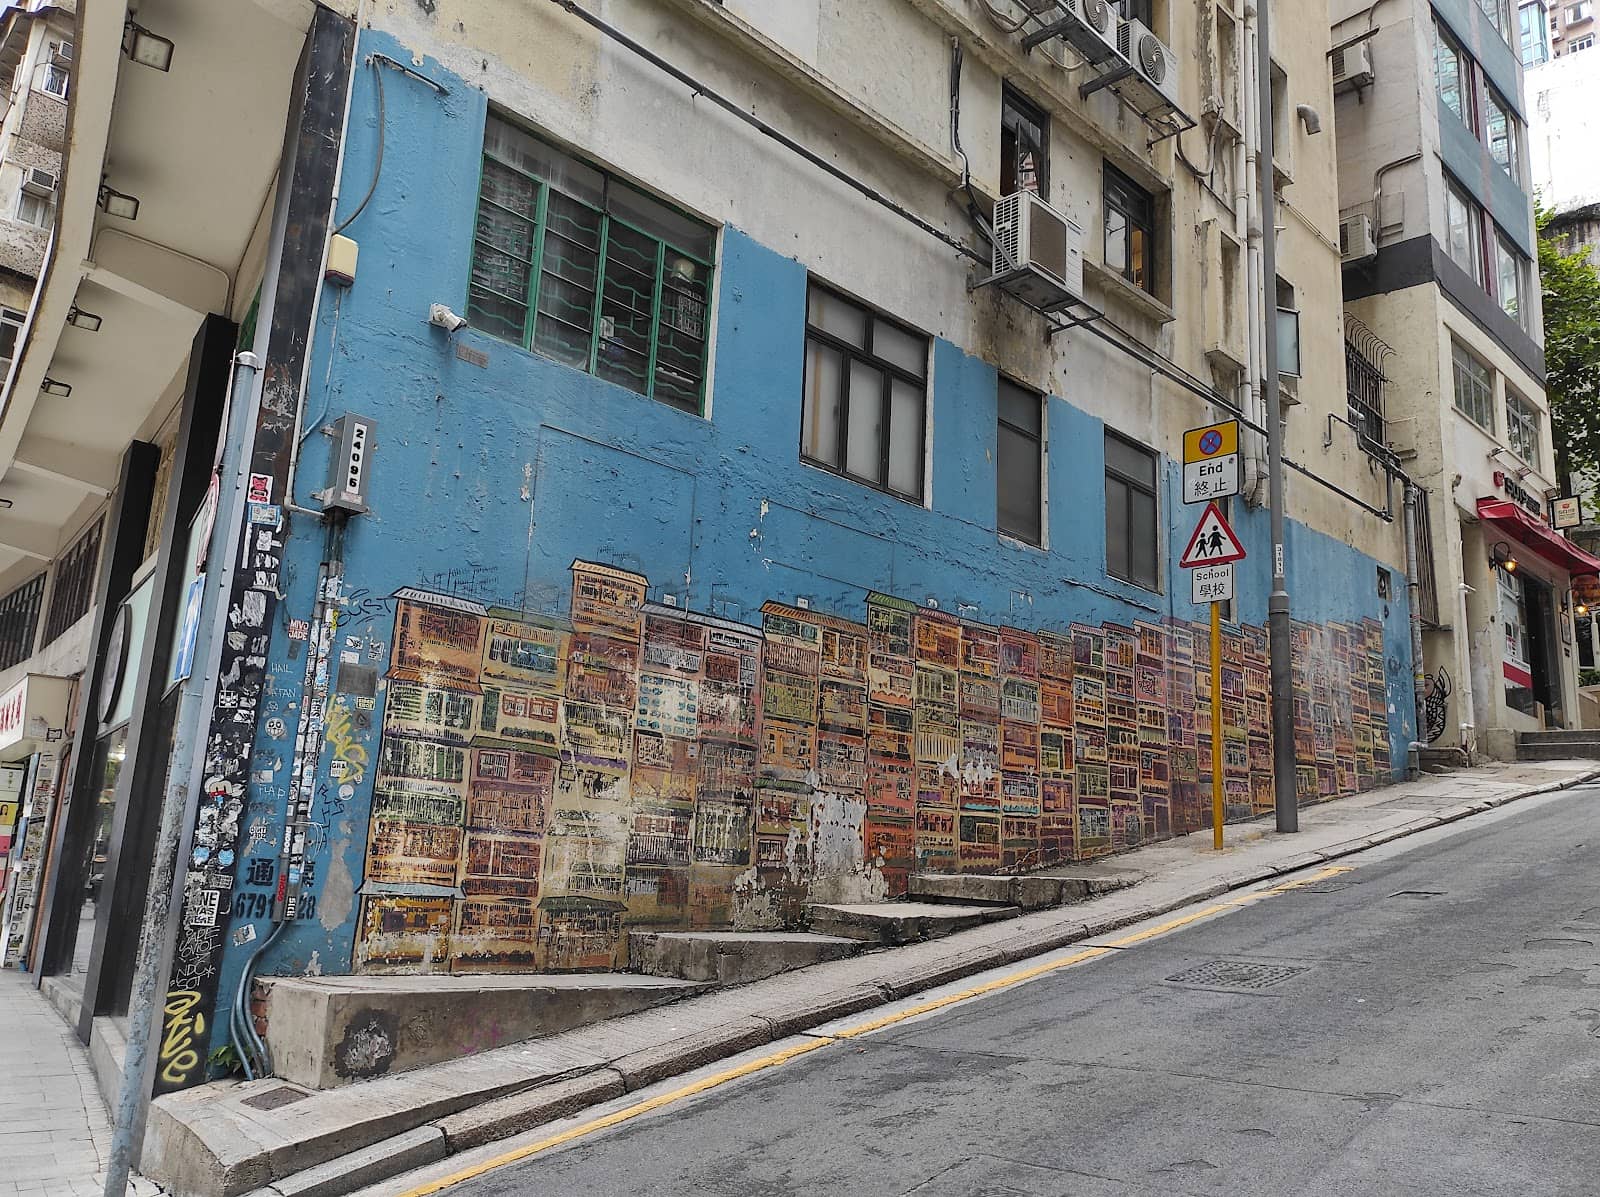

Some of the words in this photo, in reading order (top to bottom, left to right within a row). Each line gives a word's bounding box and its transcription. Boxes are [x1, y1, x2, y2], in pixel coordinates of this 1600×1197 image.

[349, 428, 365, 488] 24096
[1199, 462, 1223, 477] End
[1194, 477, 1228, 497] 終止
[1196, 568, 1229, 581] School
[1199, 582, 1225, 598] 學校
